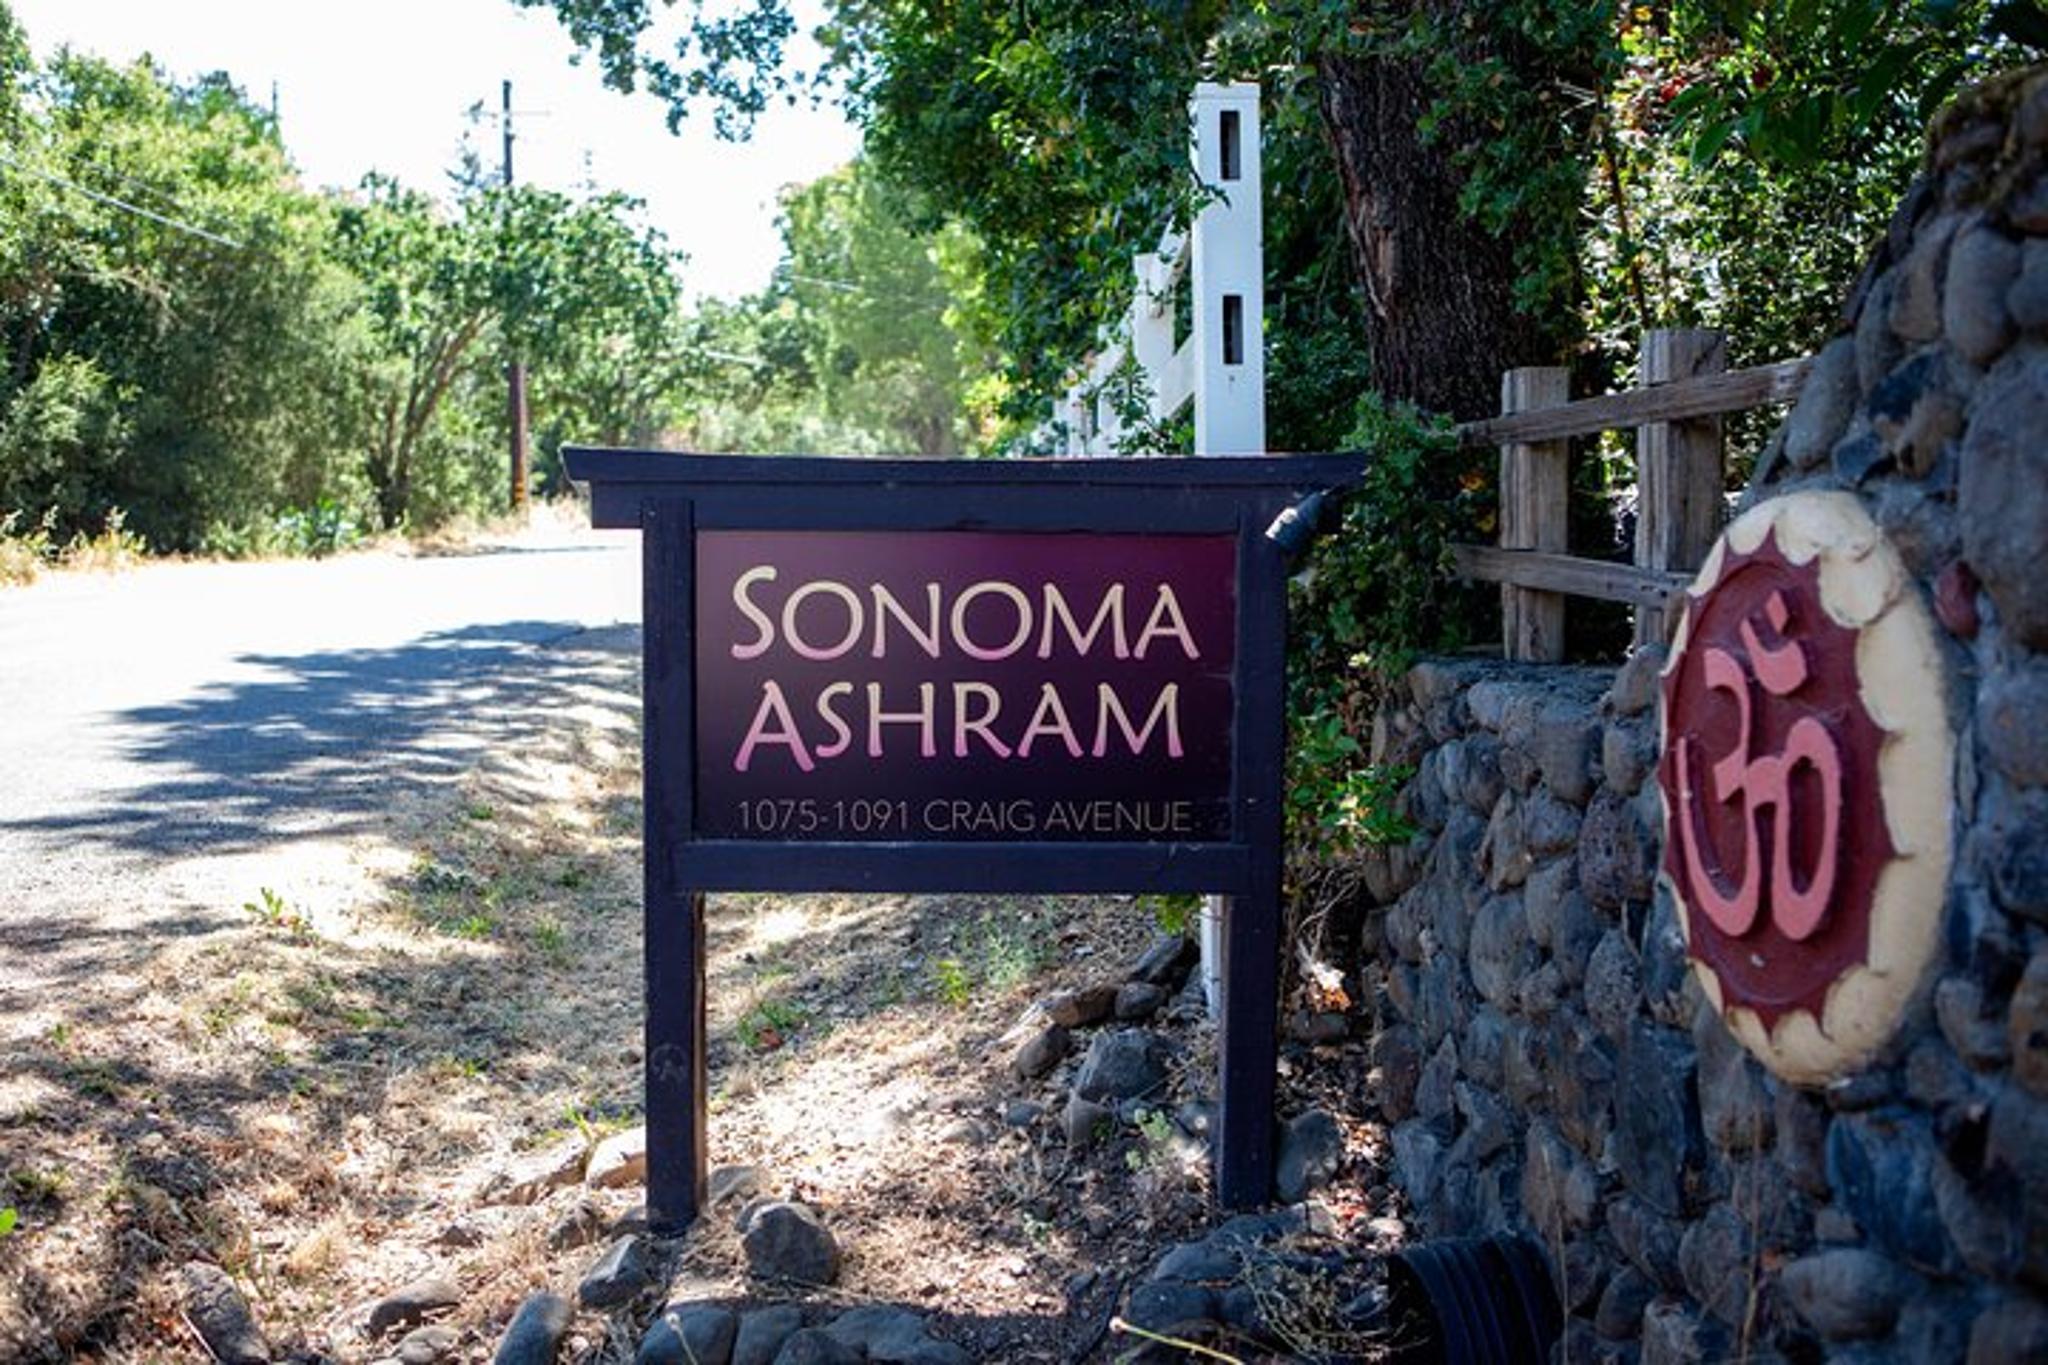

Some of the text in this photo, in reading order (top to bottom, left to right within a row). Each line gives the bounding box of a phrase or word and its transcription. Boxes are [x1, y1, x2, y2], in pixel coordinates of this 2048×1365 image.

[731, 566, 1200, 659] SONOMA
[734, 680, 1184, 772] ASHRAM
[738, 800, 1192, 833] 1075-1091 CRAIG AVENUE
